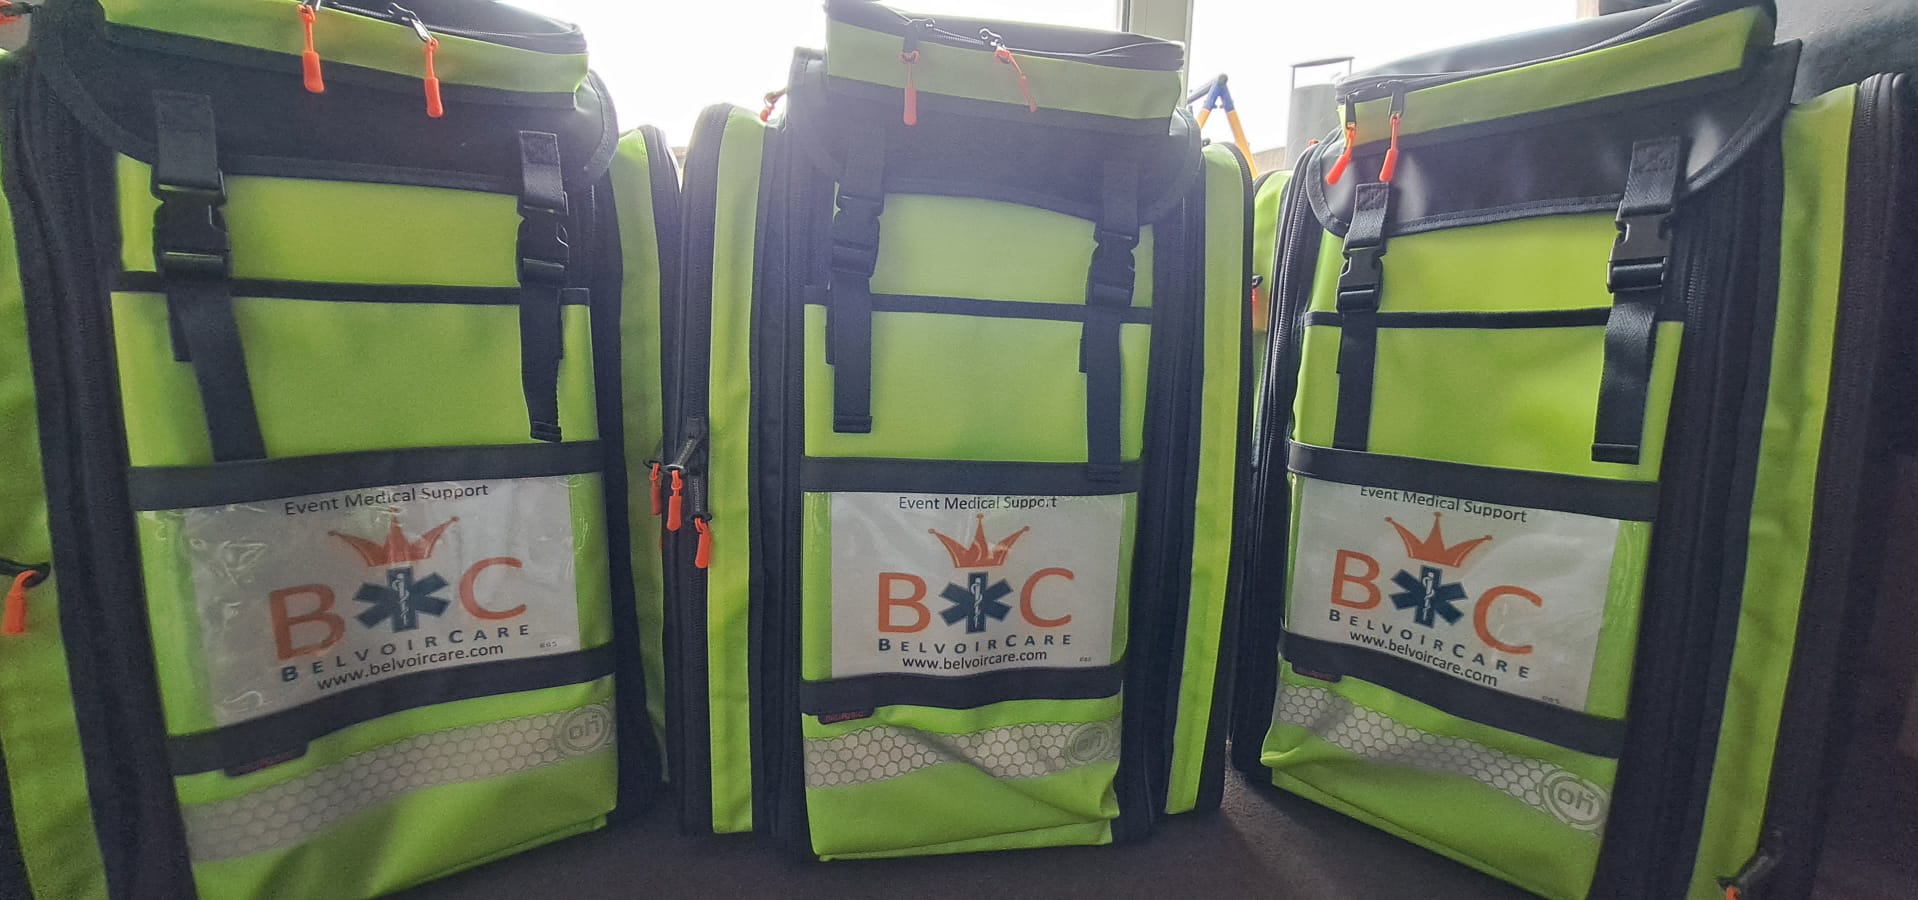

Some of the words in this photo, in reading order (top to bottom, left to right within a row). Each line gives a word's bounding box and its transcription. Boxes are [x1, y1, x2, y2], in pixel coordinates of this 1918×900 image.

[285, 498, 339, 516] Event
[344, 487, 416, 509] Medical
[420, 484, 489, 501] Support
[899, 496, 940, 510] Event
[944, 496, 1000, 510] Medical
[1360, 486, 1399, 501] Event
[1402, 490, 1460, 512] Medical
[1463, 499, 1528, 523] Support
[317, 642, 504, 691] www.belvoircare.com
[902, 650, 1048, 670] www.belvoircare.com
[1349, 630, 1498, 688] www.belvoircare.com
